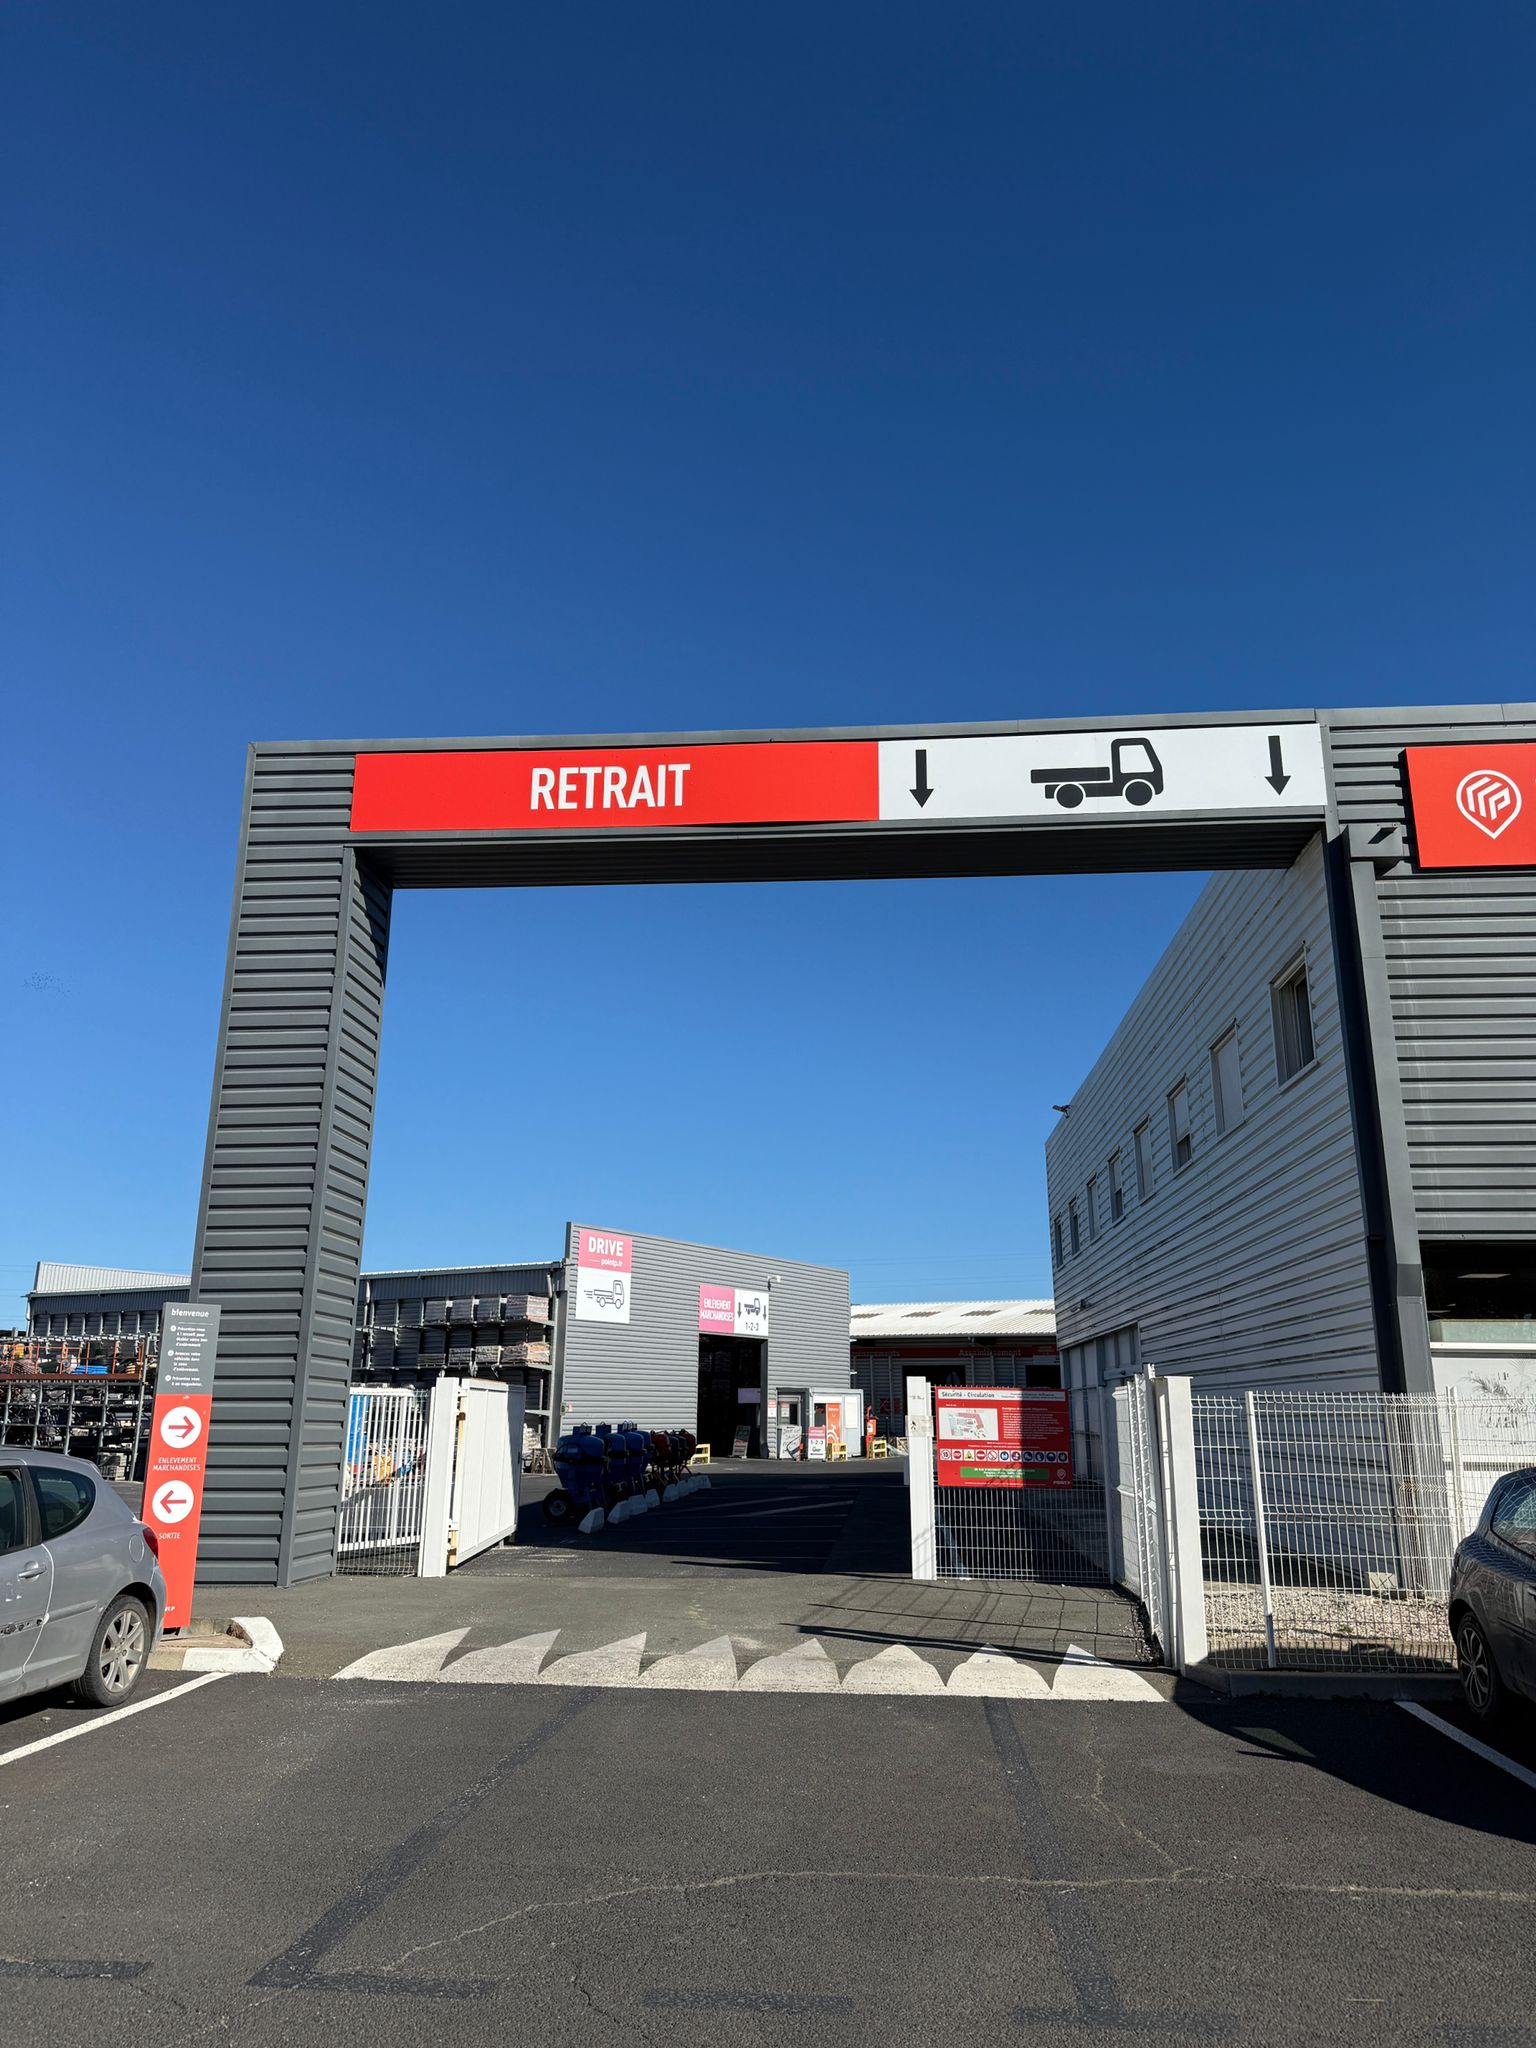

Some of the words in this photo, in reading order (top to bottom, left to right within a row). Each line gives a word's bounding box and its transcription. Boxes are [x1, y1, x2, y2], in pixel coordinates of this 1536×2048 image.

[530, 763, 691, 810] RETRAIT
[588, 1236, 624, 1257] DRIVE
[171, 1308, 210, 1318] bienvenue
[158, 1456, 197, 1464] ENLEVEMENT
[153, 1463, 201, 1471] MARCHANDISES
[158, 1531, 181, 1540] SORTIE
